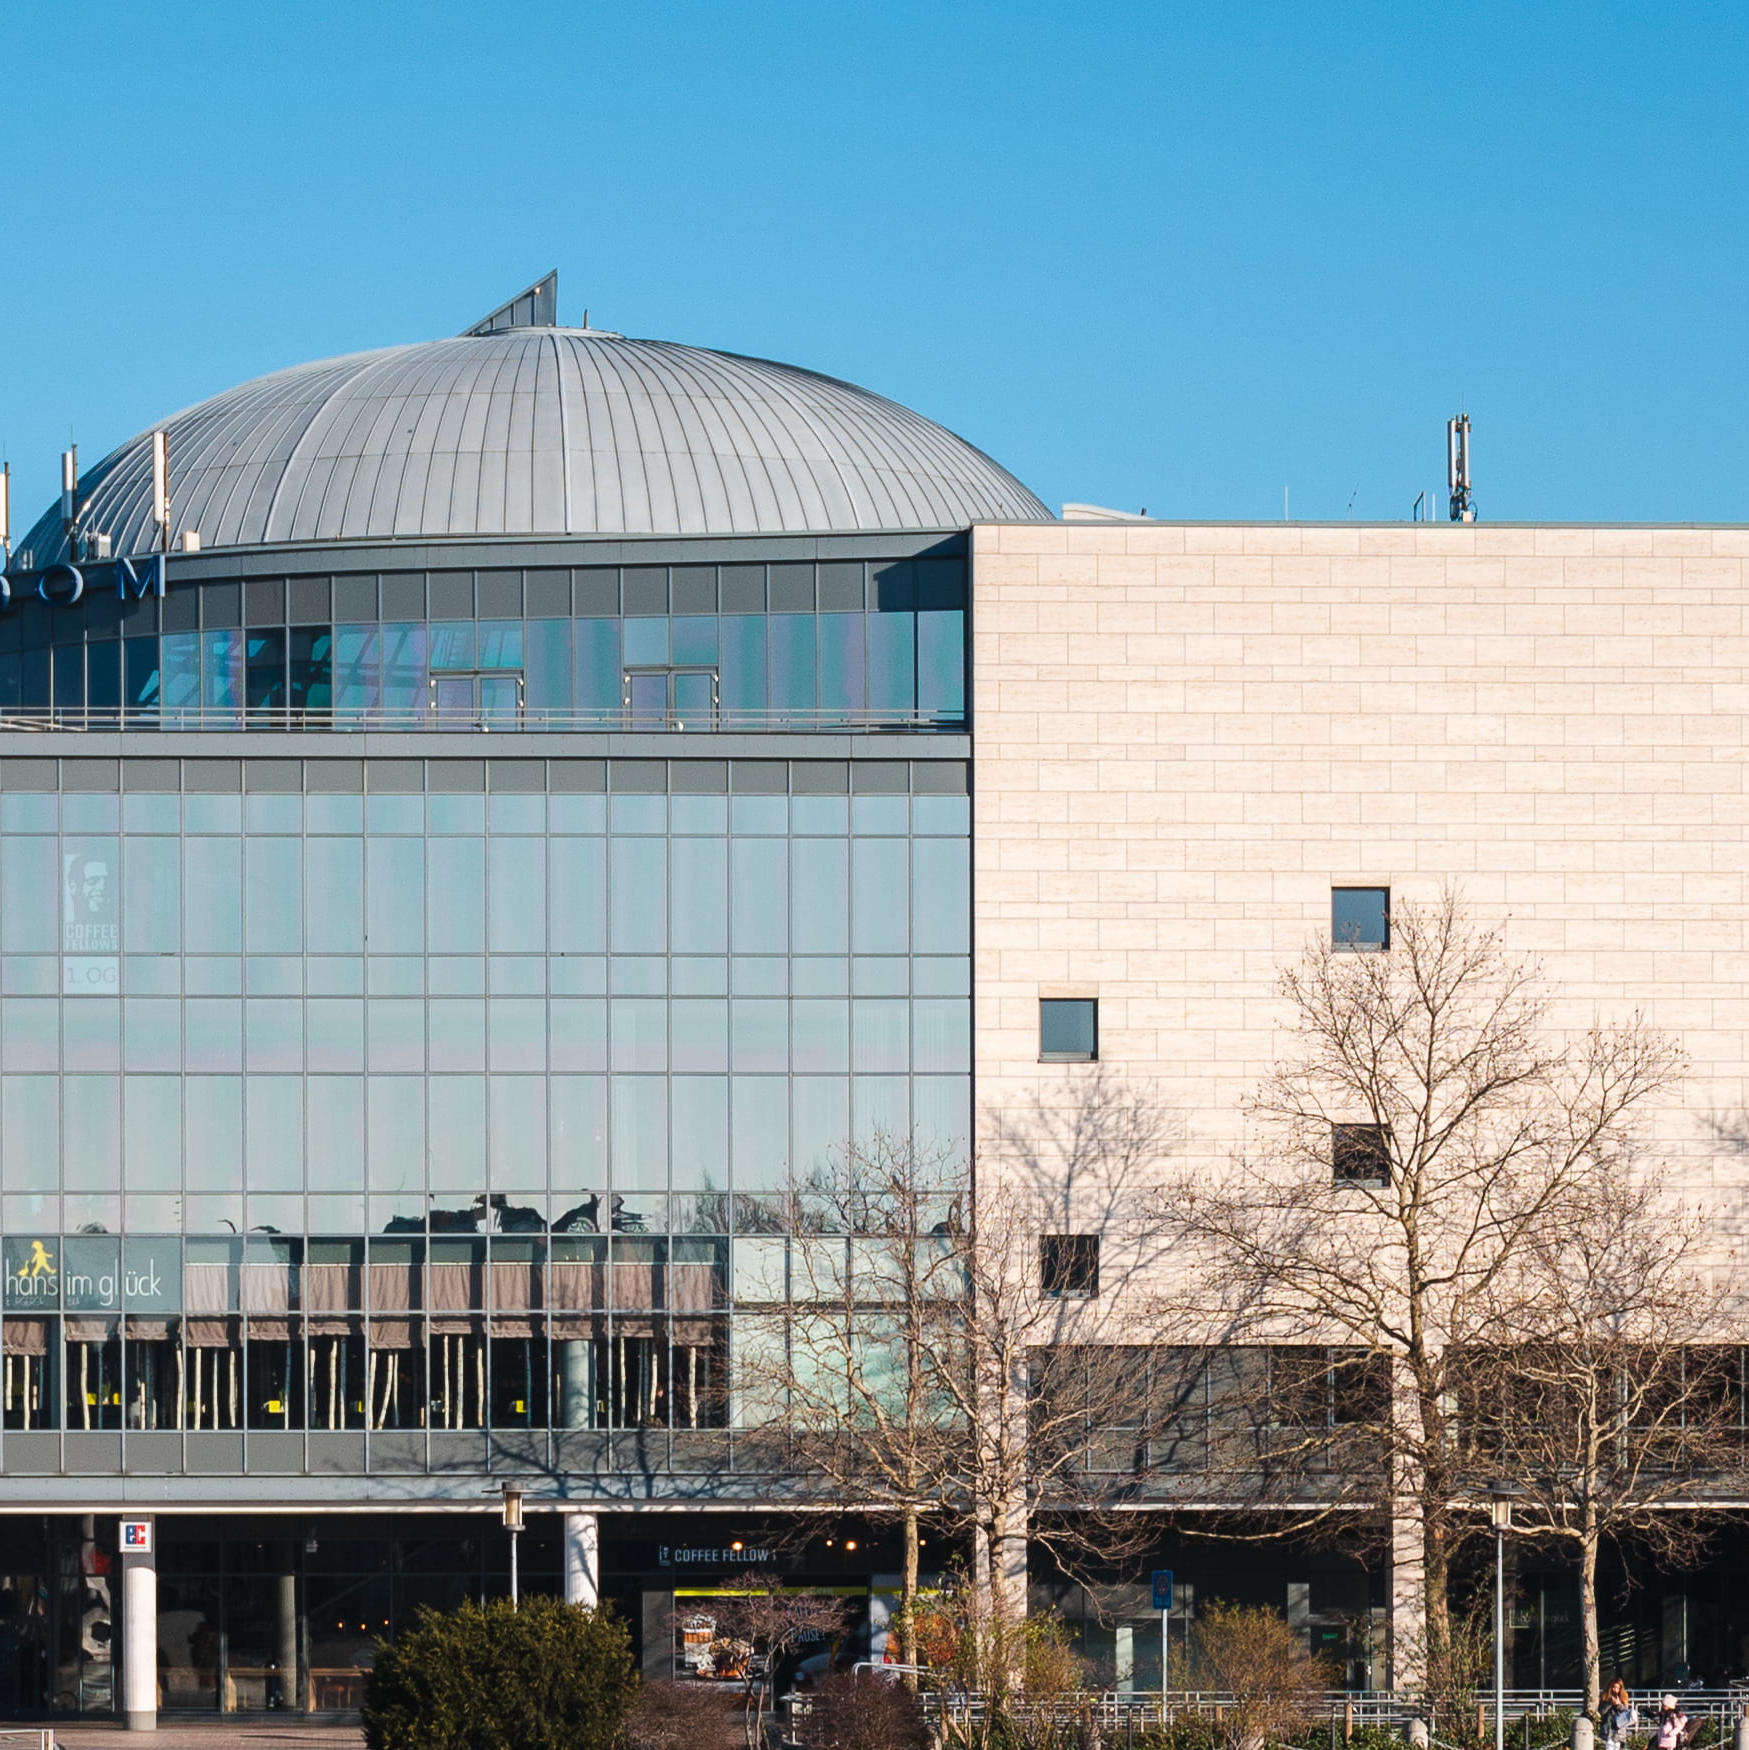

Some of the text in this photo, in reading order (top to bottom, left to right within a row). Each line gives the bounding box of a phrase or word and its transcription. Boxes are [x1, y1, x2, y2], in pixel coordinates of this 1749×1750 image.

[5, 1258, 162, 1306] hans im glück
[126, 1524, 146, 1545] ec
[674, 1548, 719, 1563] COFFEE
